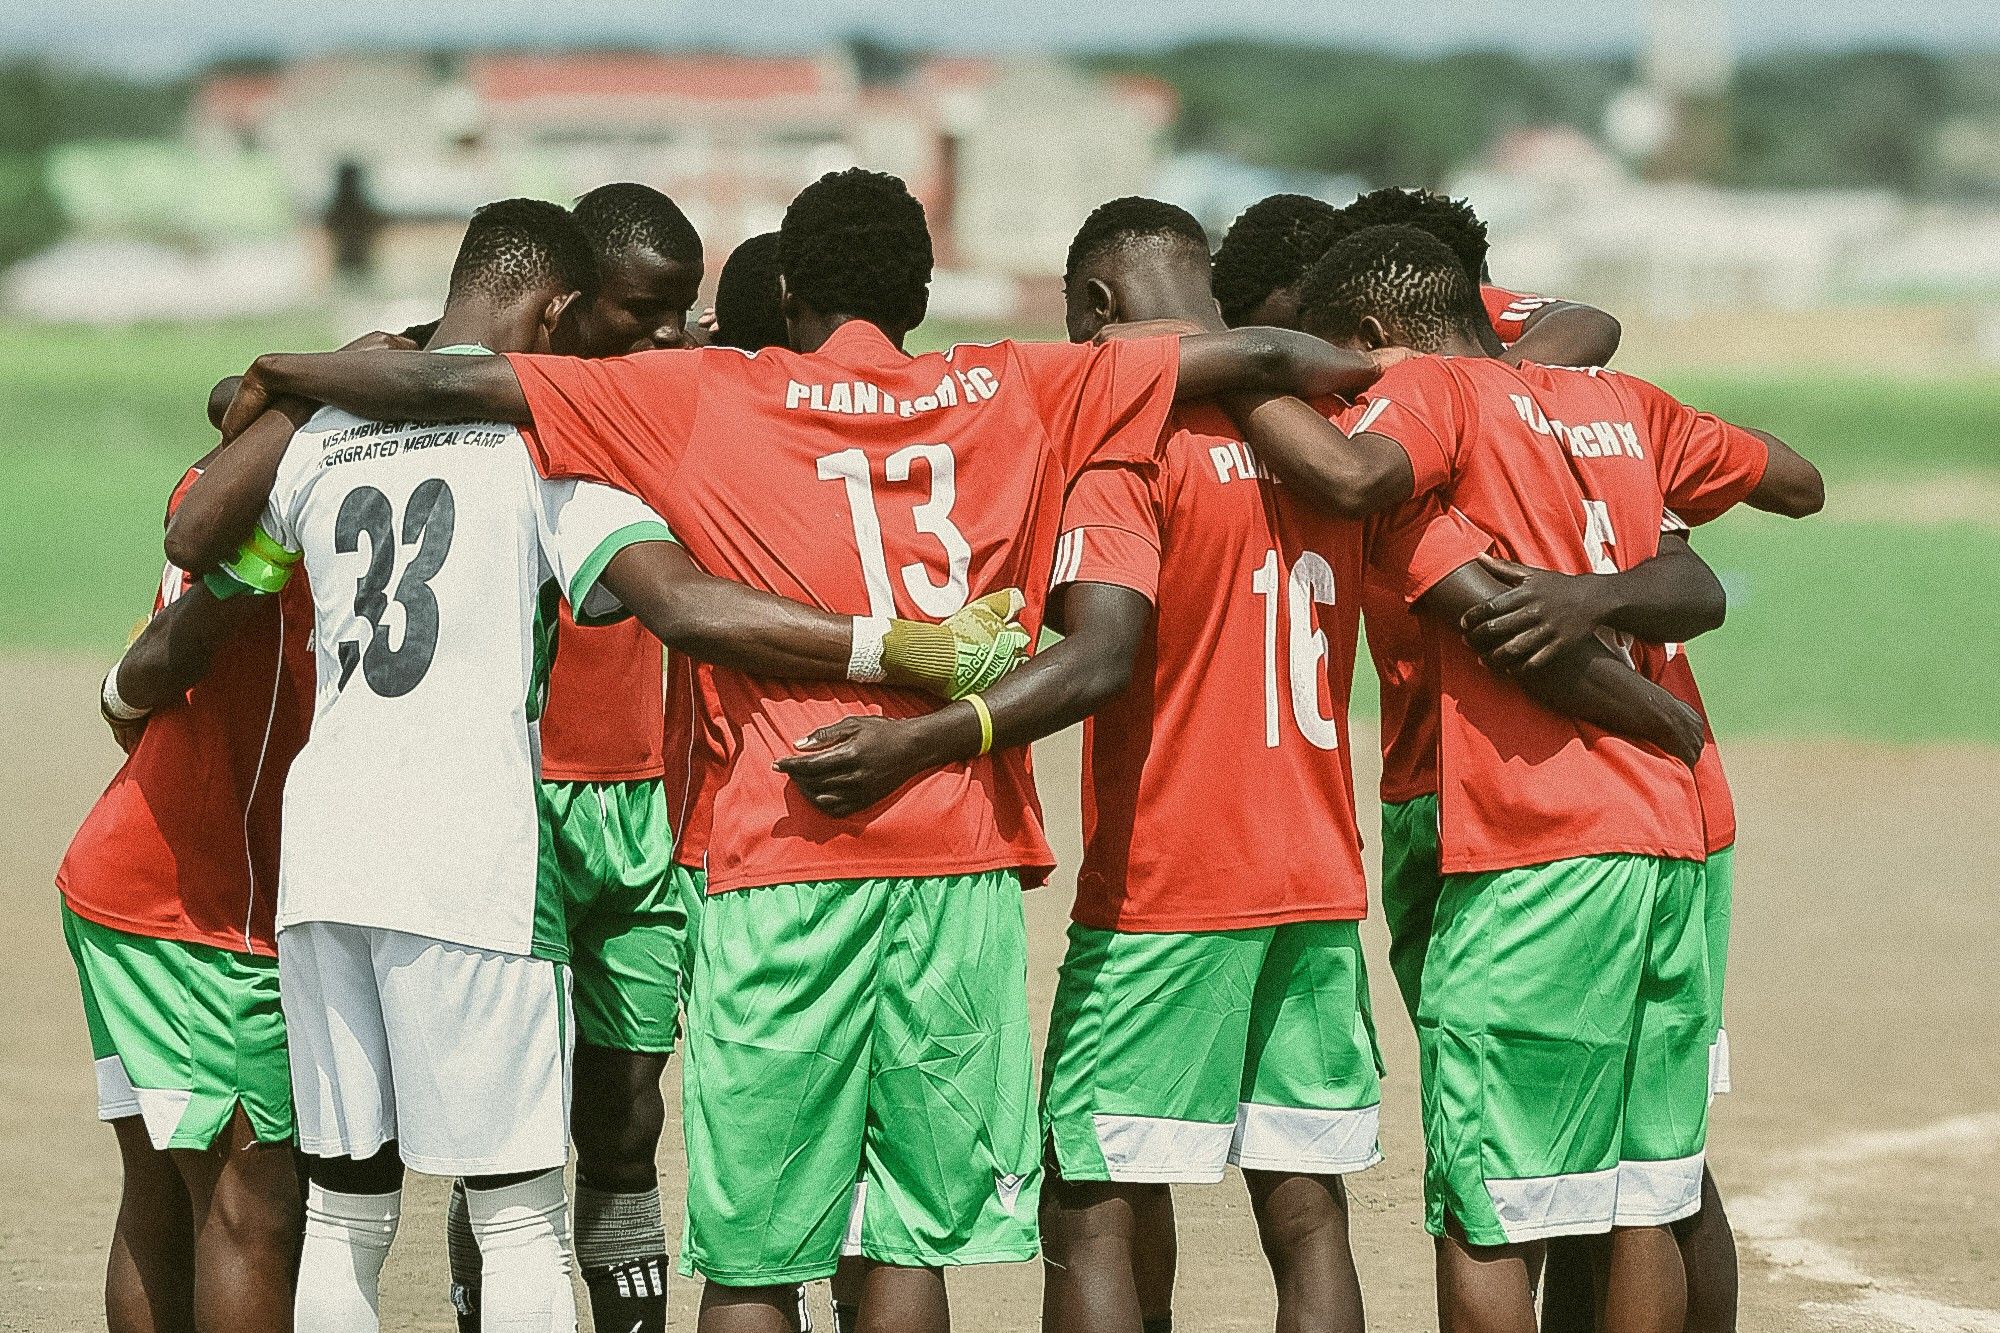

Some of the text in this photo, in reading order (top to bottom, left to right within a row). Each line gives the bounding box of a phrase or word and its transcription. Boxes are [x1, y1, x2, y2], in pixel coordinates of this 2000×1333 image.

[403, 431, 460, 454] MEDICAL
[463, 430, 506, 448] CAMP
[816, 443, 972, 618] 13
[334, 477, 456, 698] 33
[1253, 549, 1338, 750] 16
